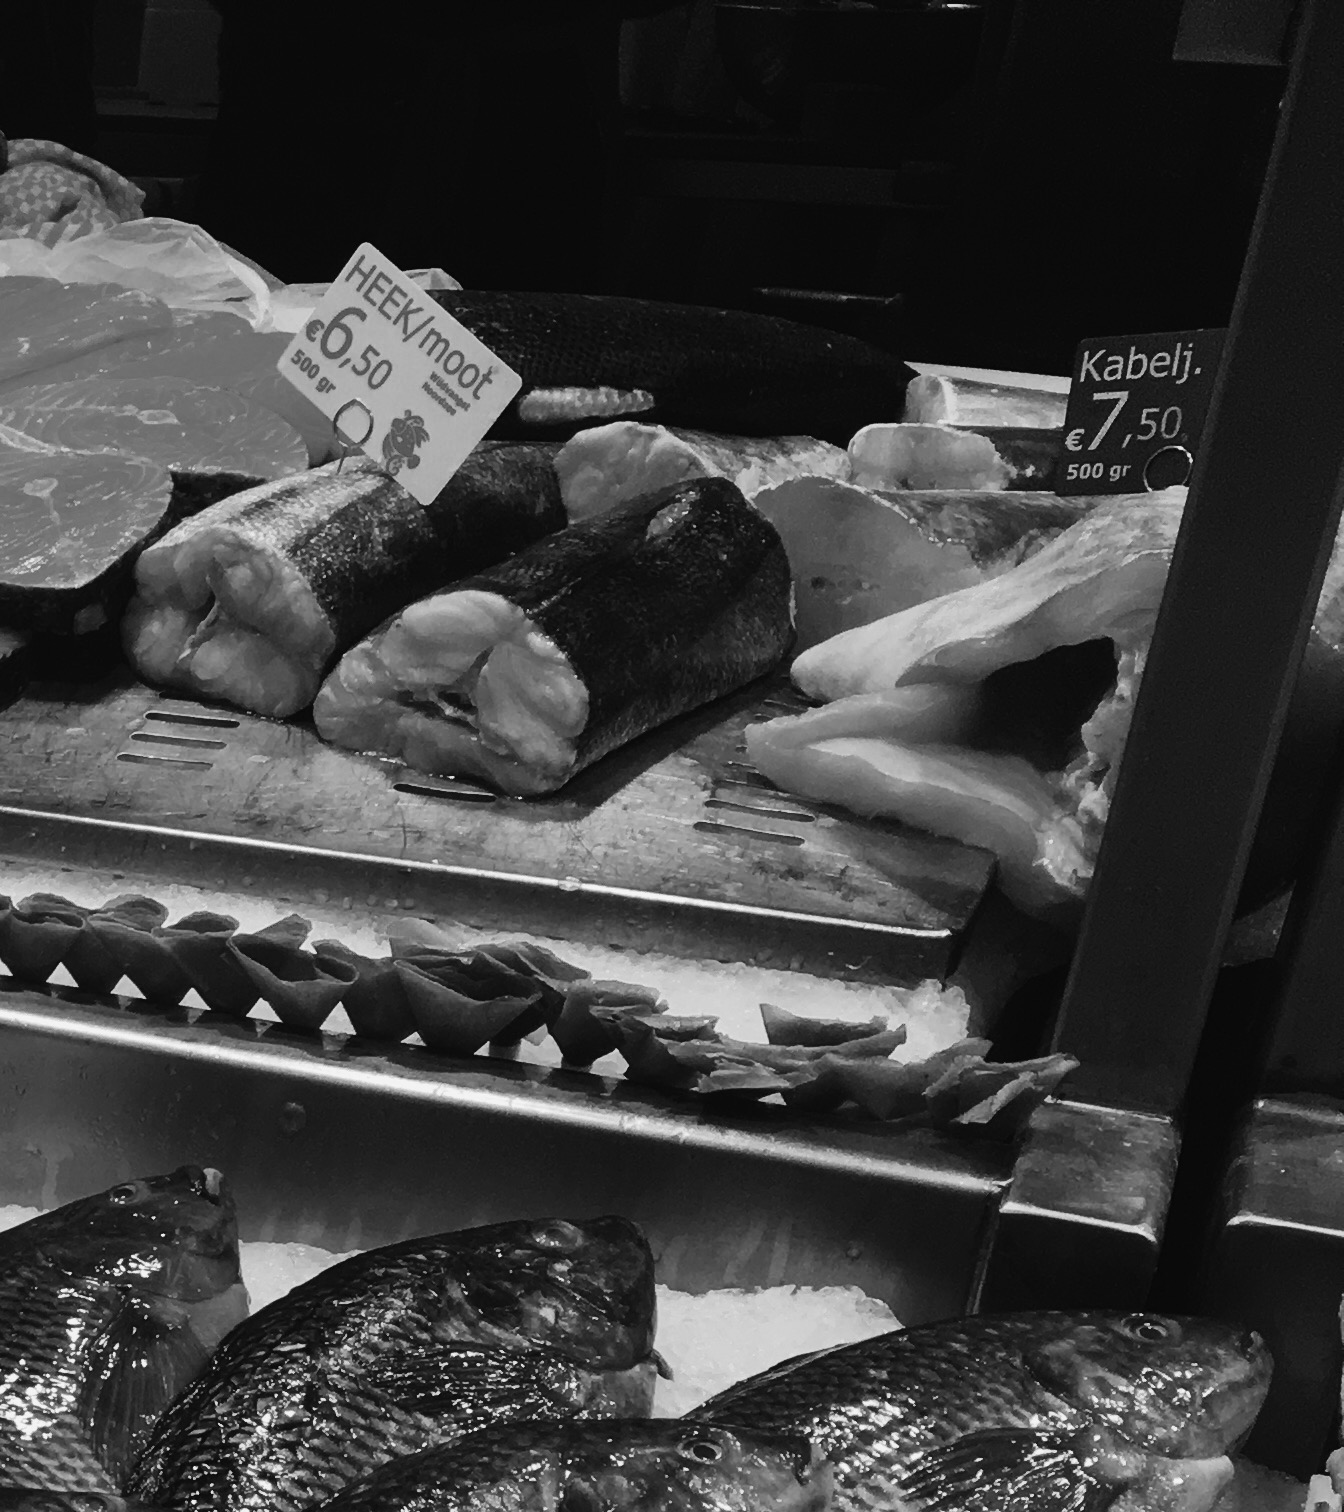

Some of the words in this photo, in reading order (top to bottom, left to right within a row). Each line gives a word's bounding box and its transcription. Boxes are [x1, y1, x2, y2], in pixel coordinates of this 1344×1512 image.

[345, 254, 494, 400] HEEK/moot
[290, 349, 320, 380] 500
[315, 375, 337, 394] gr
[1079, 342, 1202, 384] Kabelj.
[429, 371, 471, 412] Wildvangst
[1066, 462, 1104, 481] 500
[1109, 464, 1132, 482] gr
